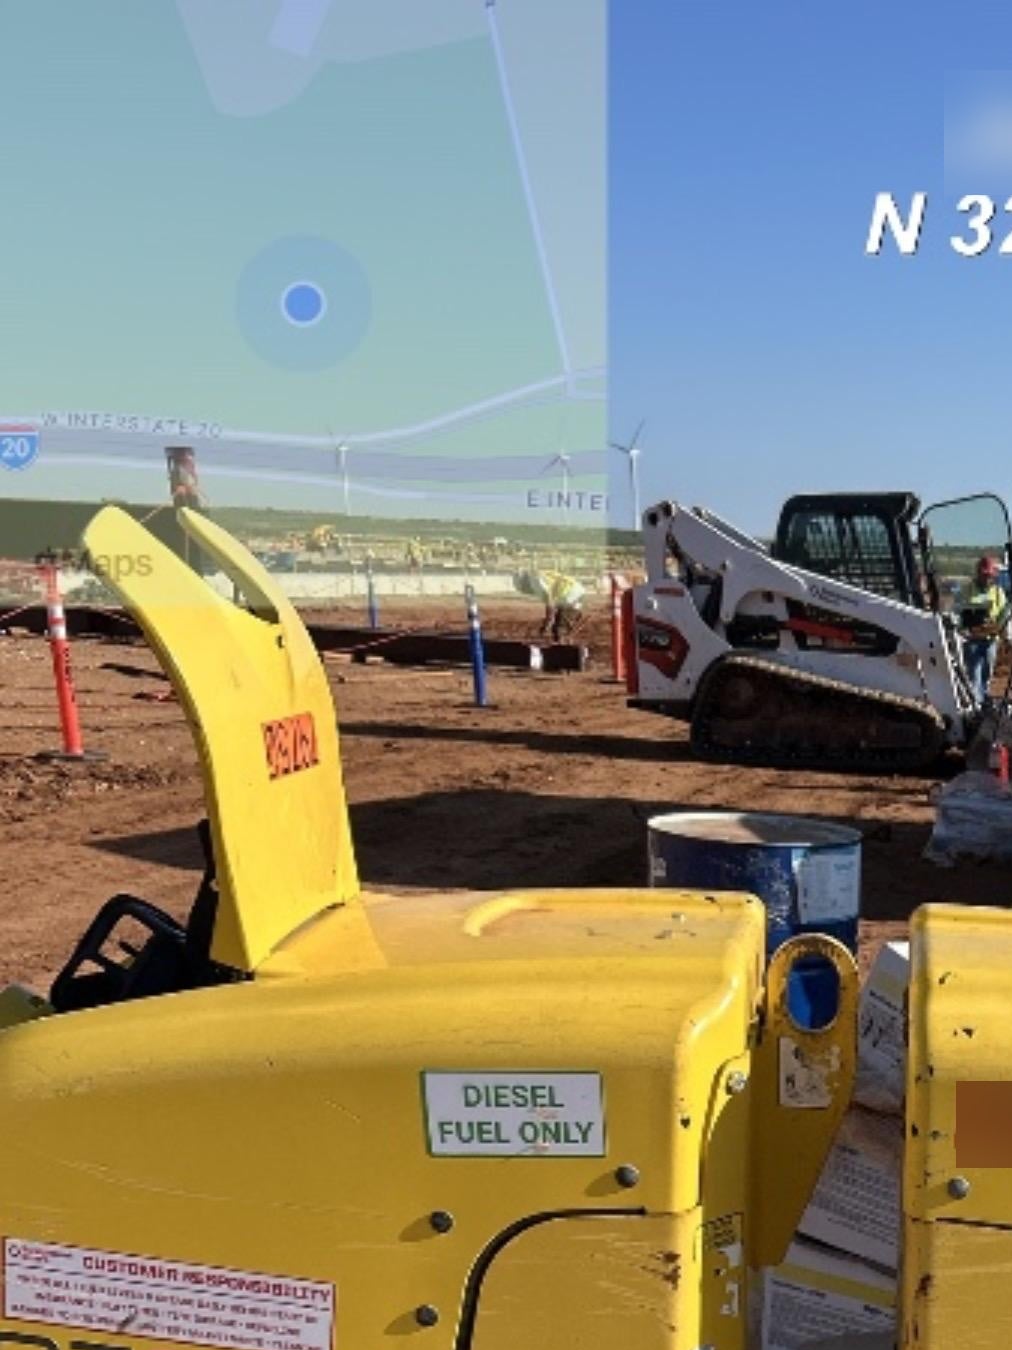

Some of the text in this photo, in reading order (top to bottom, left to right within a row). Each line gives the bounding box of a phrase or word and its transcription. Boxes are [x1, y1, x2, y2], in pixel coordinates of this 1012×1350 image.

[463, 1085, 565, 1108] DIESEL
[437, 1121, 594, 1144] FUEL ONLY
